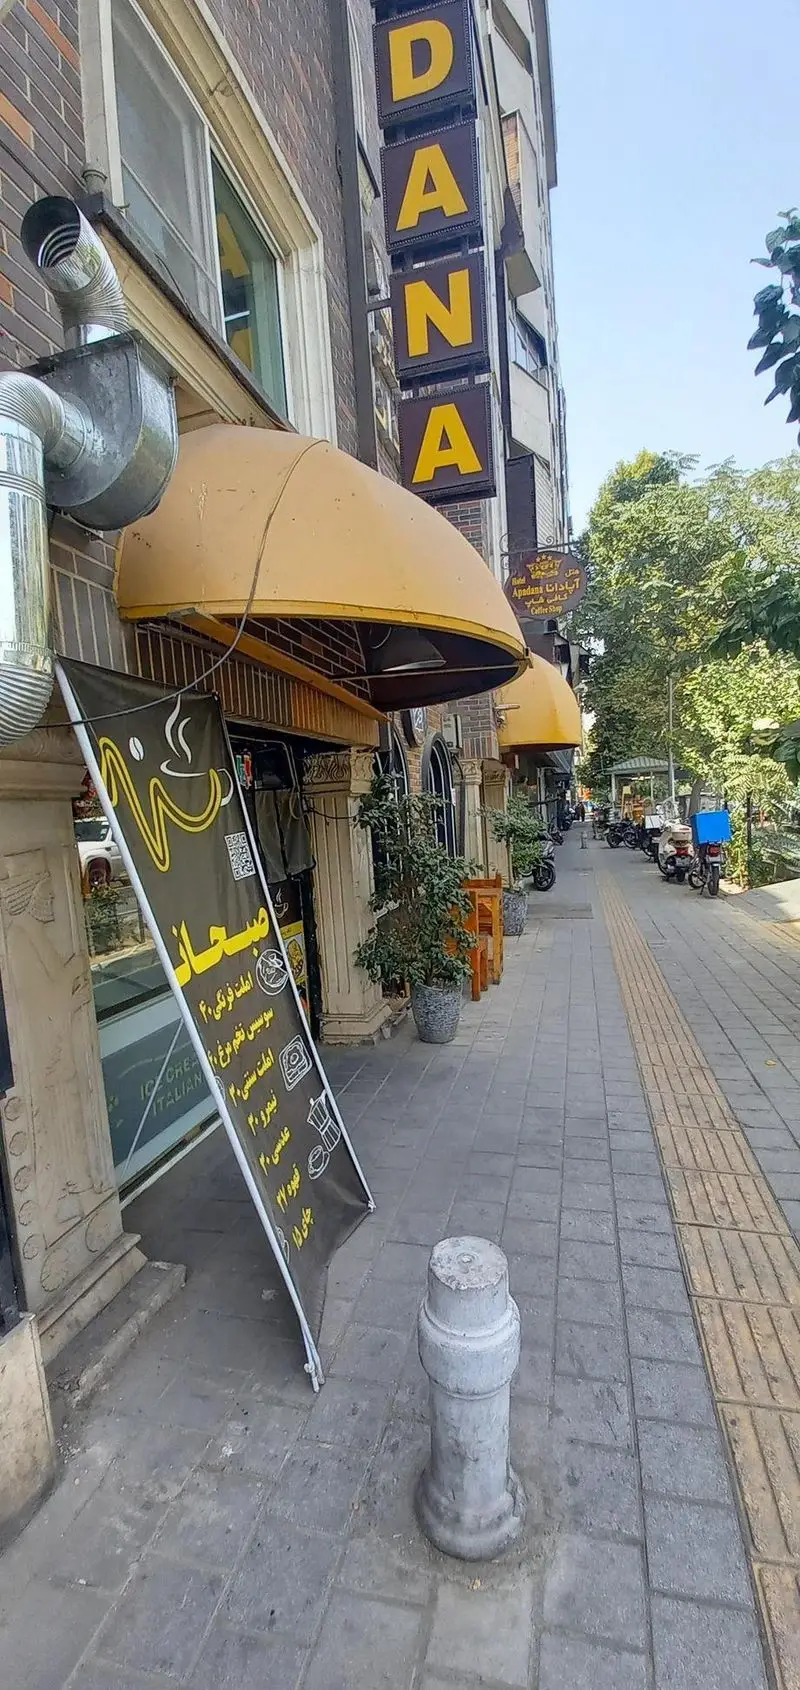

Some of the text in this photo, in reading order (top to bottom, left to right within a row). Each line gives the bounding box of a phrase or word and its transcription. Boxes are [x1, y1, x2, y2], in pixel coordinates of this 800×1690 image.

[545, 577, 580, 594] آپادانا
[565, 568, 580, 578] هتل
[511, 585, 544, 599] Apadana
[524, 593, 568, 608] کافی شاپ
[173, 907, 270, 987] صبحان
[234, 970, 254, 999] املت
[212, 982, 235, 1021] فرنگی
[232, 1022, 246, 1055] تخم
[246, 1007, 274, 1041] سوسیس
[216, 1039, 233, 1069] مرغ
[256, 1047, 275, 1077] املت
[152, 1071, 205, 1117] ITALIAN
[240, 1070, 258, 1101] سنتی
[260, 1088, 278, 1129] نیمرو
[271, 1126, 291, 1165] عدسی
[286, 1163, 301, 1198] قهوه
[301, 1207, 314, 1239] چای
